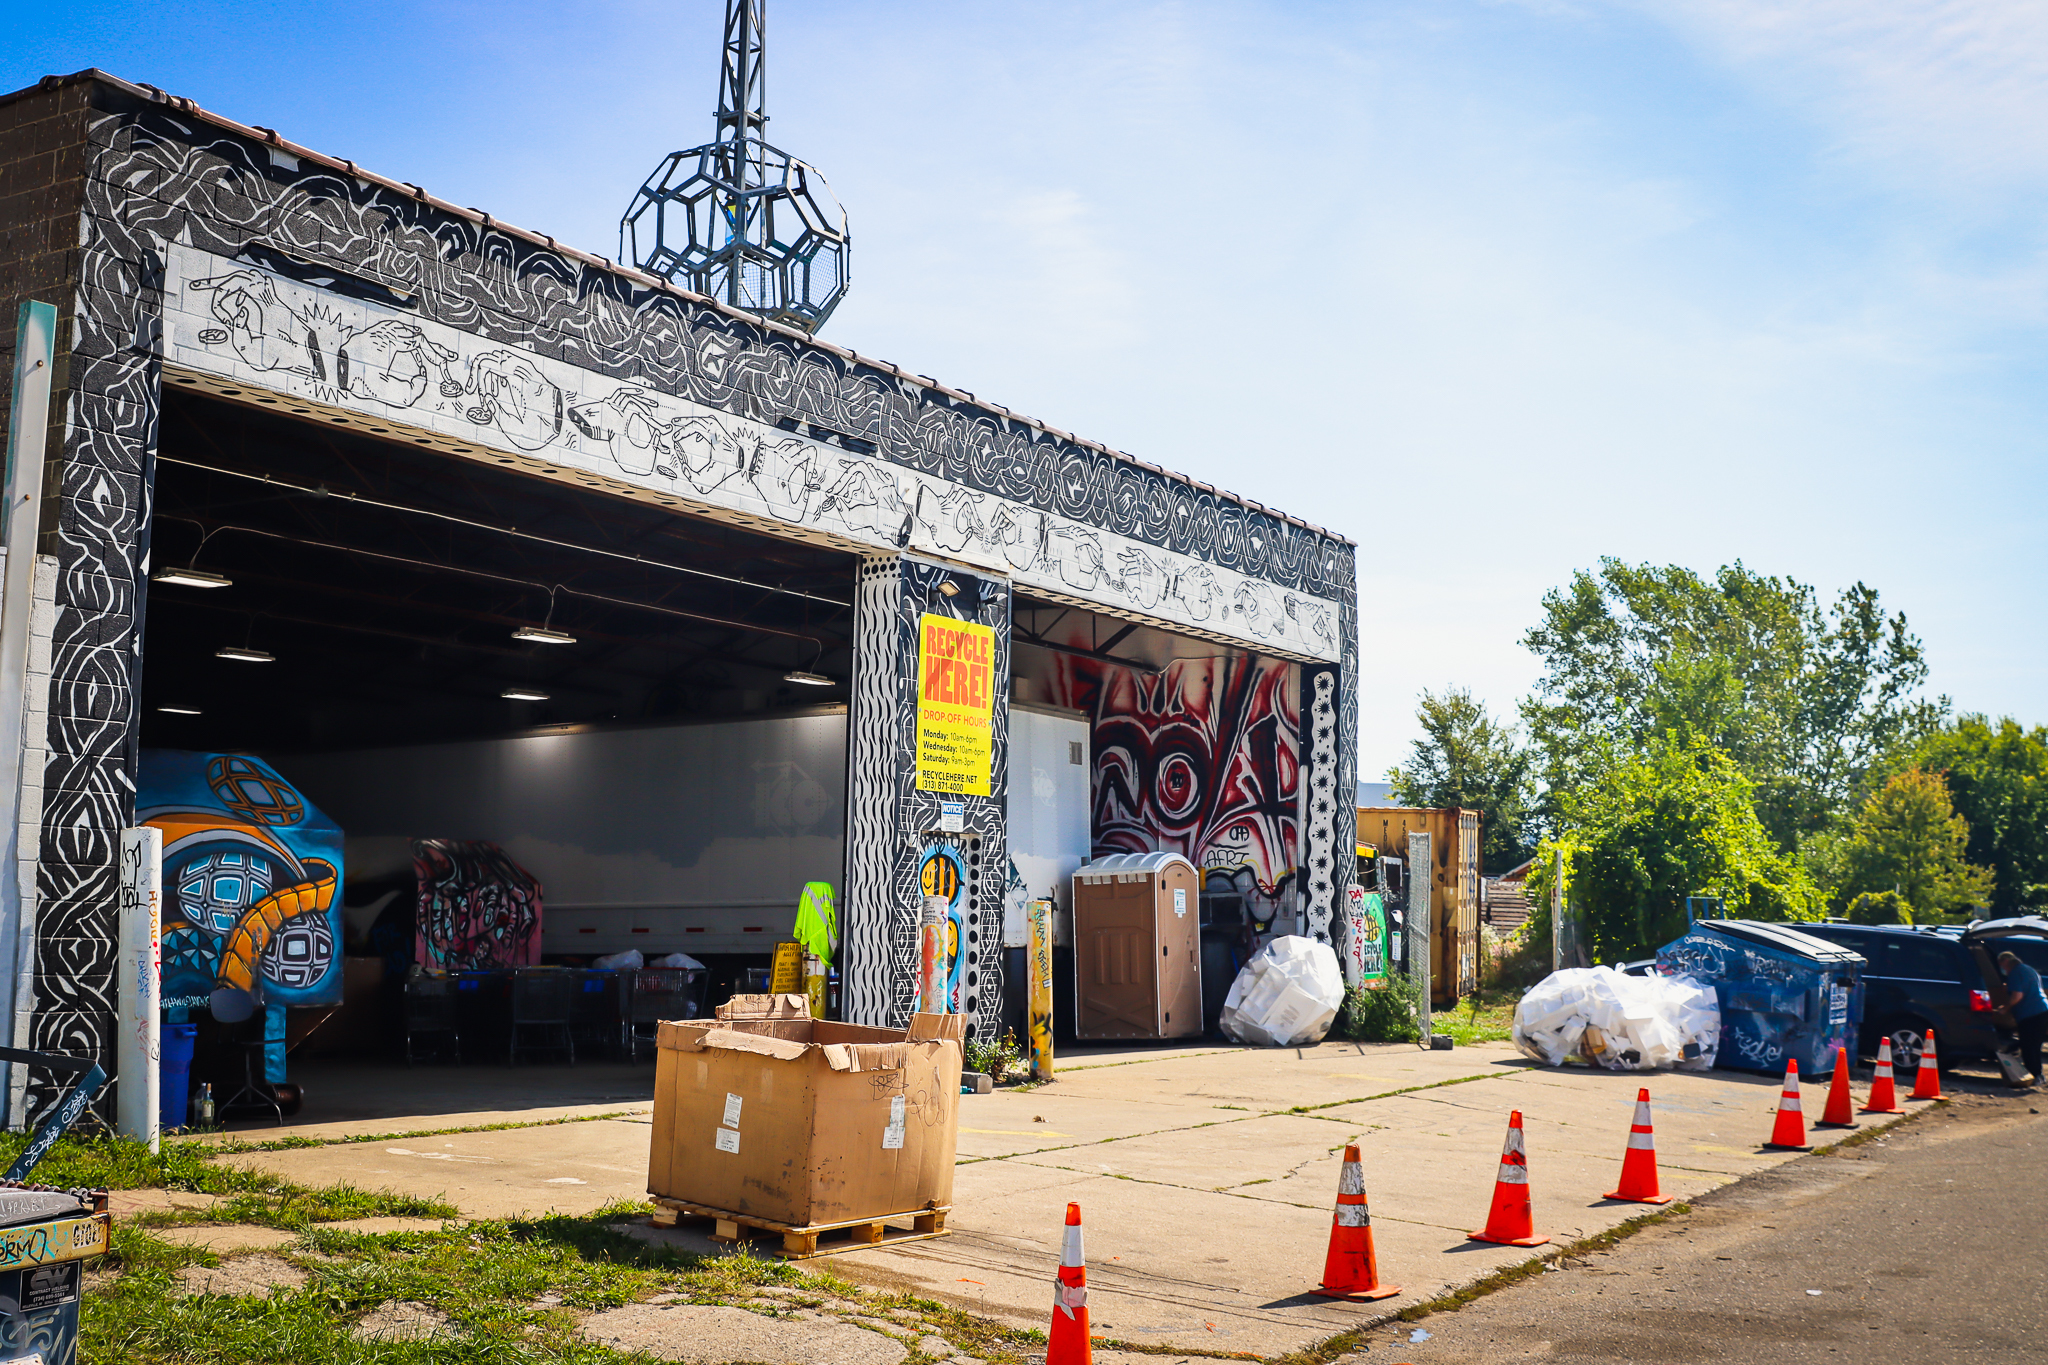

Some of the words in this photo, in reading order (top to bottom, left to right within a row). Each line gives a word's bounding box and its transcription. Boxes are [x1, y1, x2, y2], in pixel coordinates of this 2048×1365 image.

[926, 625, 989, 665] RECYCLE
[925, 655, 989, 710] HERE!
[923, 709, 962, 724] DROP-OFF
[963, 715, 987, 729] HOURS
[923, 728, 949, 742] Monday:
[950, 732, 978, 746] 10am-6pm
[922, 740, 958, 755] Wednesday:
[959, 745, 986, 759] 10am-6pm
[922, 752, 950, 766] Saturday:
[950, 755, 976, 769] 9am-3pm
[921, 779, 937, 791] (313)
[937, 781, 964, 792] 871-4000
[922, 770, 978, 784] RECYCLEHERE.NET
[942, 805, 963, 814] NOTICE
[1364, 943, 1382, 955] ECYCLE
[28, 1287, 51, 1296] CONTRACT
